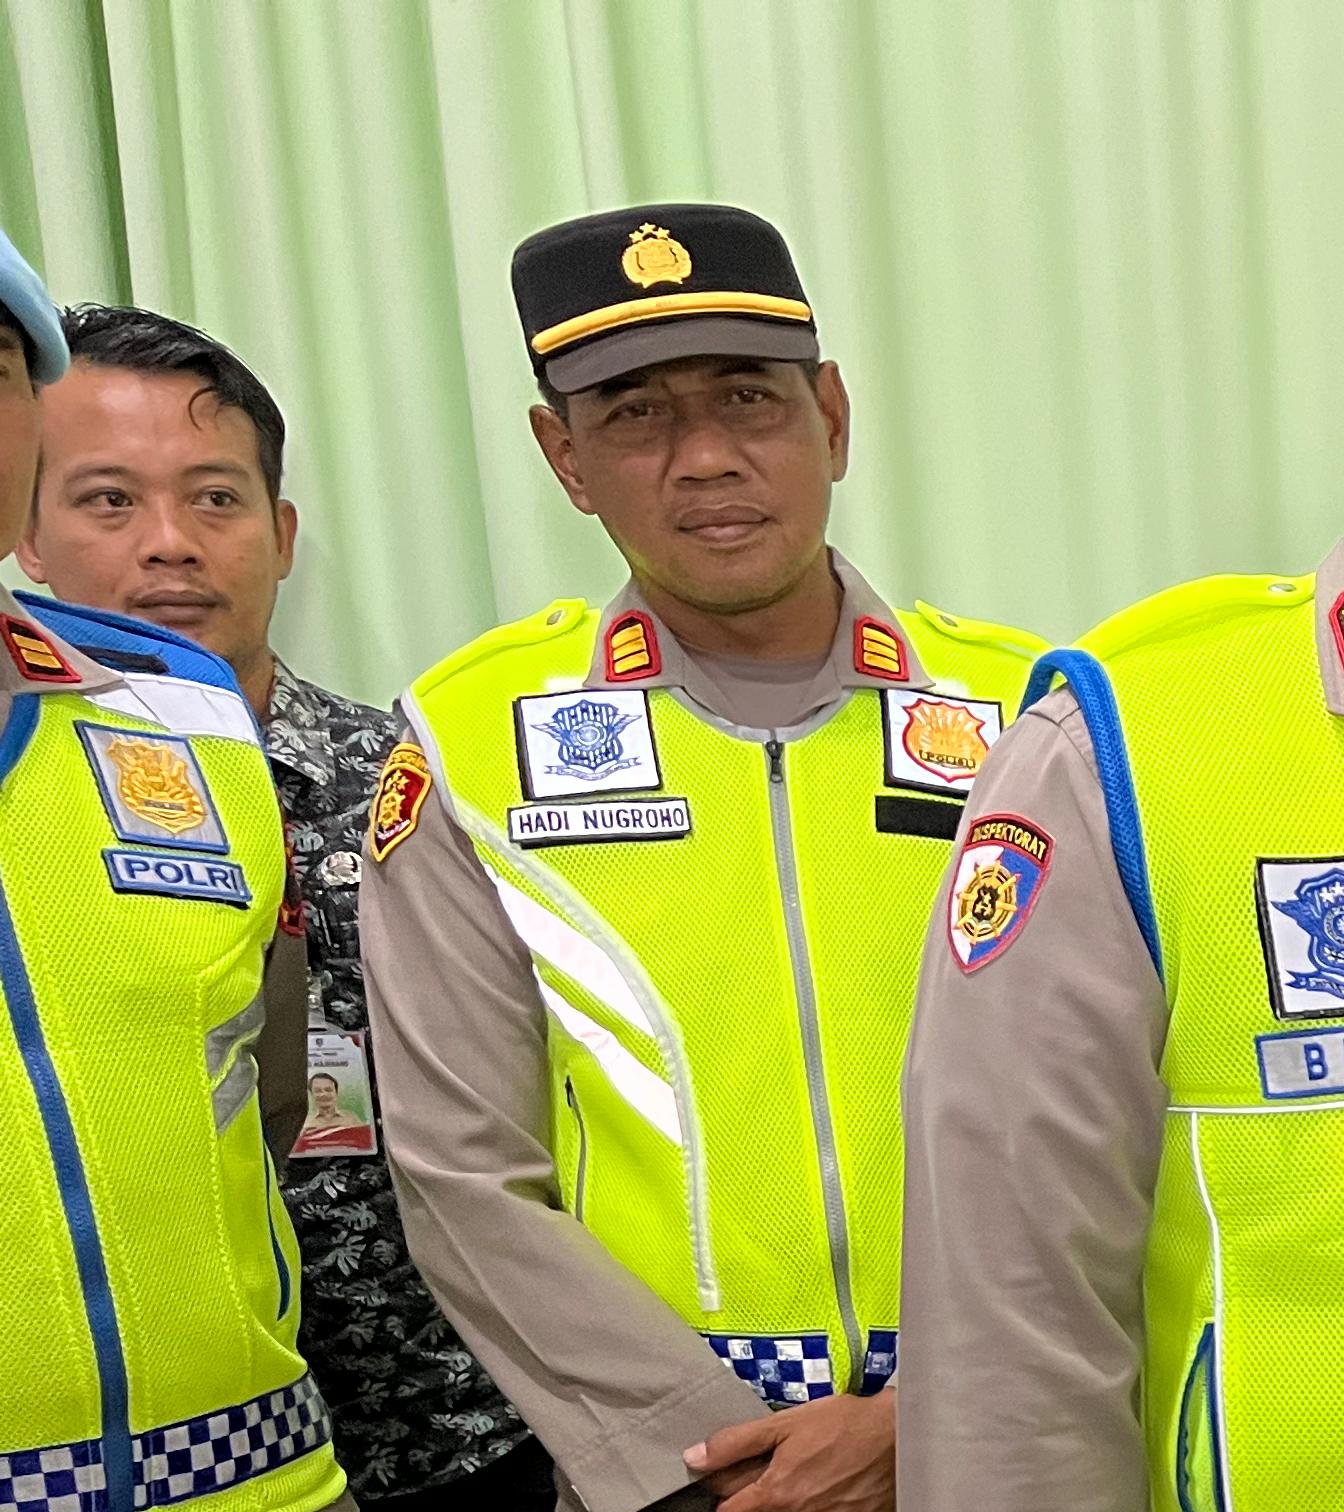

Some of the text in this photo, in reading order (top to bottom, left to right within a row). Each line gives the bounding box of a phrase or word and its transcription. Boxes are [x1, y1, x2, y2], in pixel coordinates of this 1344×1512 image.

[519, 808, 684, 833] HADI NUGROHO
[971, 823, 1048, 860] INSPEKTORAT
[124, 859, 238, 891] POLRI
